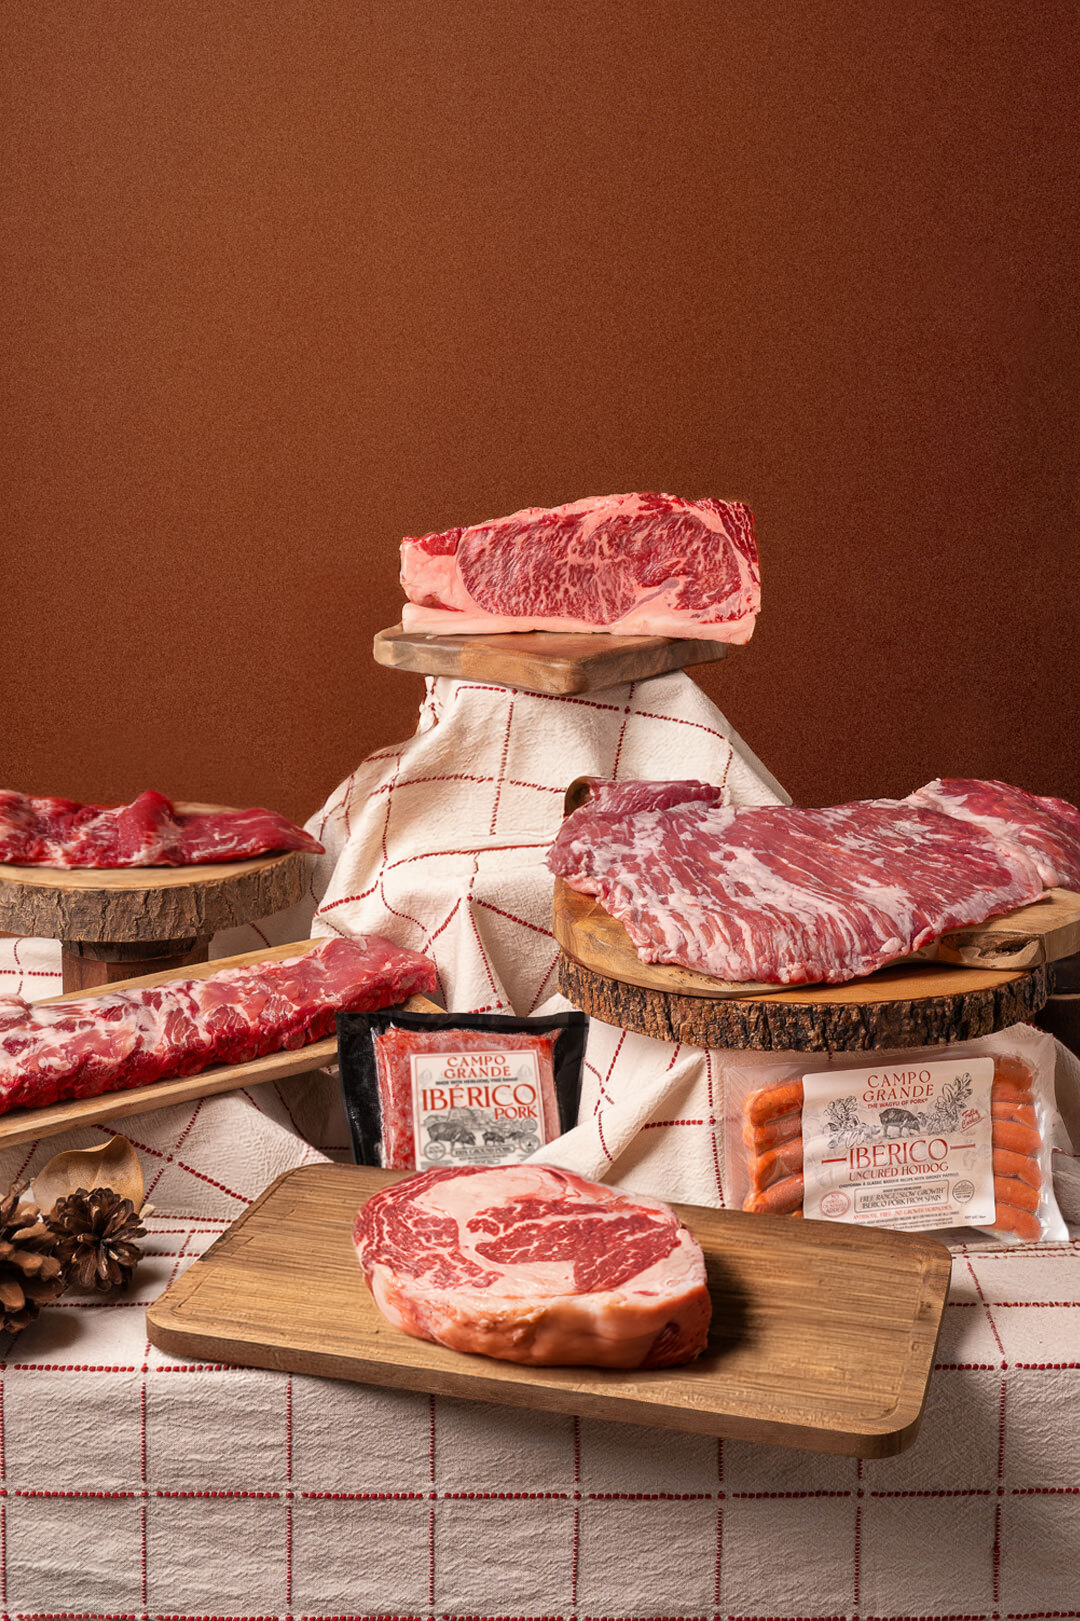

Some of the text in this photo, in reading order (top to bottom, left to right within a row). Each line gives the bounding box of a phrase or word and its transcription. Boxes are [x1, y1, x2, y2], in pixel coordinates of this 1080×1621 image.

[446, 1055, 506, 1068] CAMPO
[444, 1066, 512, 1079] GRANDE
[867, 1070, 931, 1088] CAMPO
[422, 1083, 537, 1111] IBÉRICO
[862, 1084, 934, 1102] GRANDE
[494, 1105, 538, 1120] PORK
[962, 1108, 978, 1118] Fully
[850, 1138, 948, 1170] IBÉRICO
[849, 1162, 949, 1182] UNCURED HOTDOG
[888, 1198, 906, 1207] PORK
[907, 1196, 924, 1204] FROM
